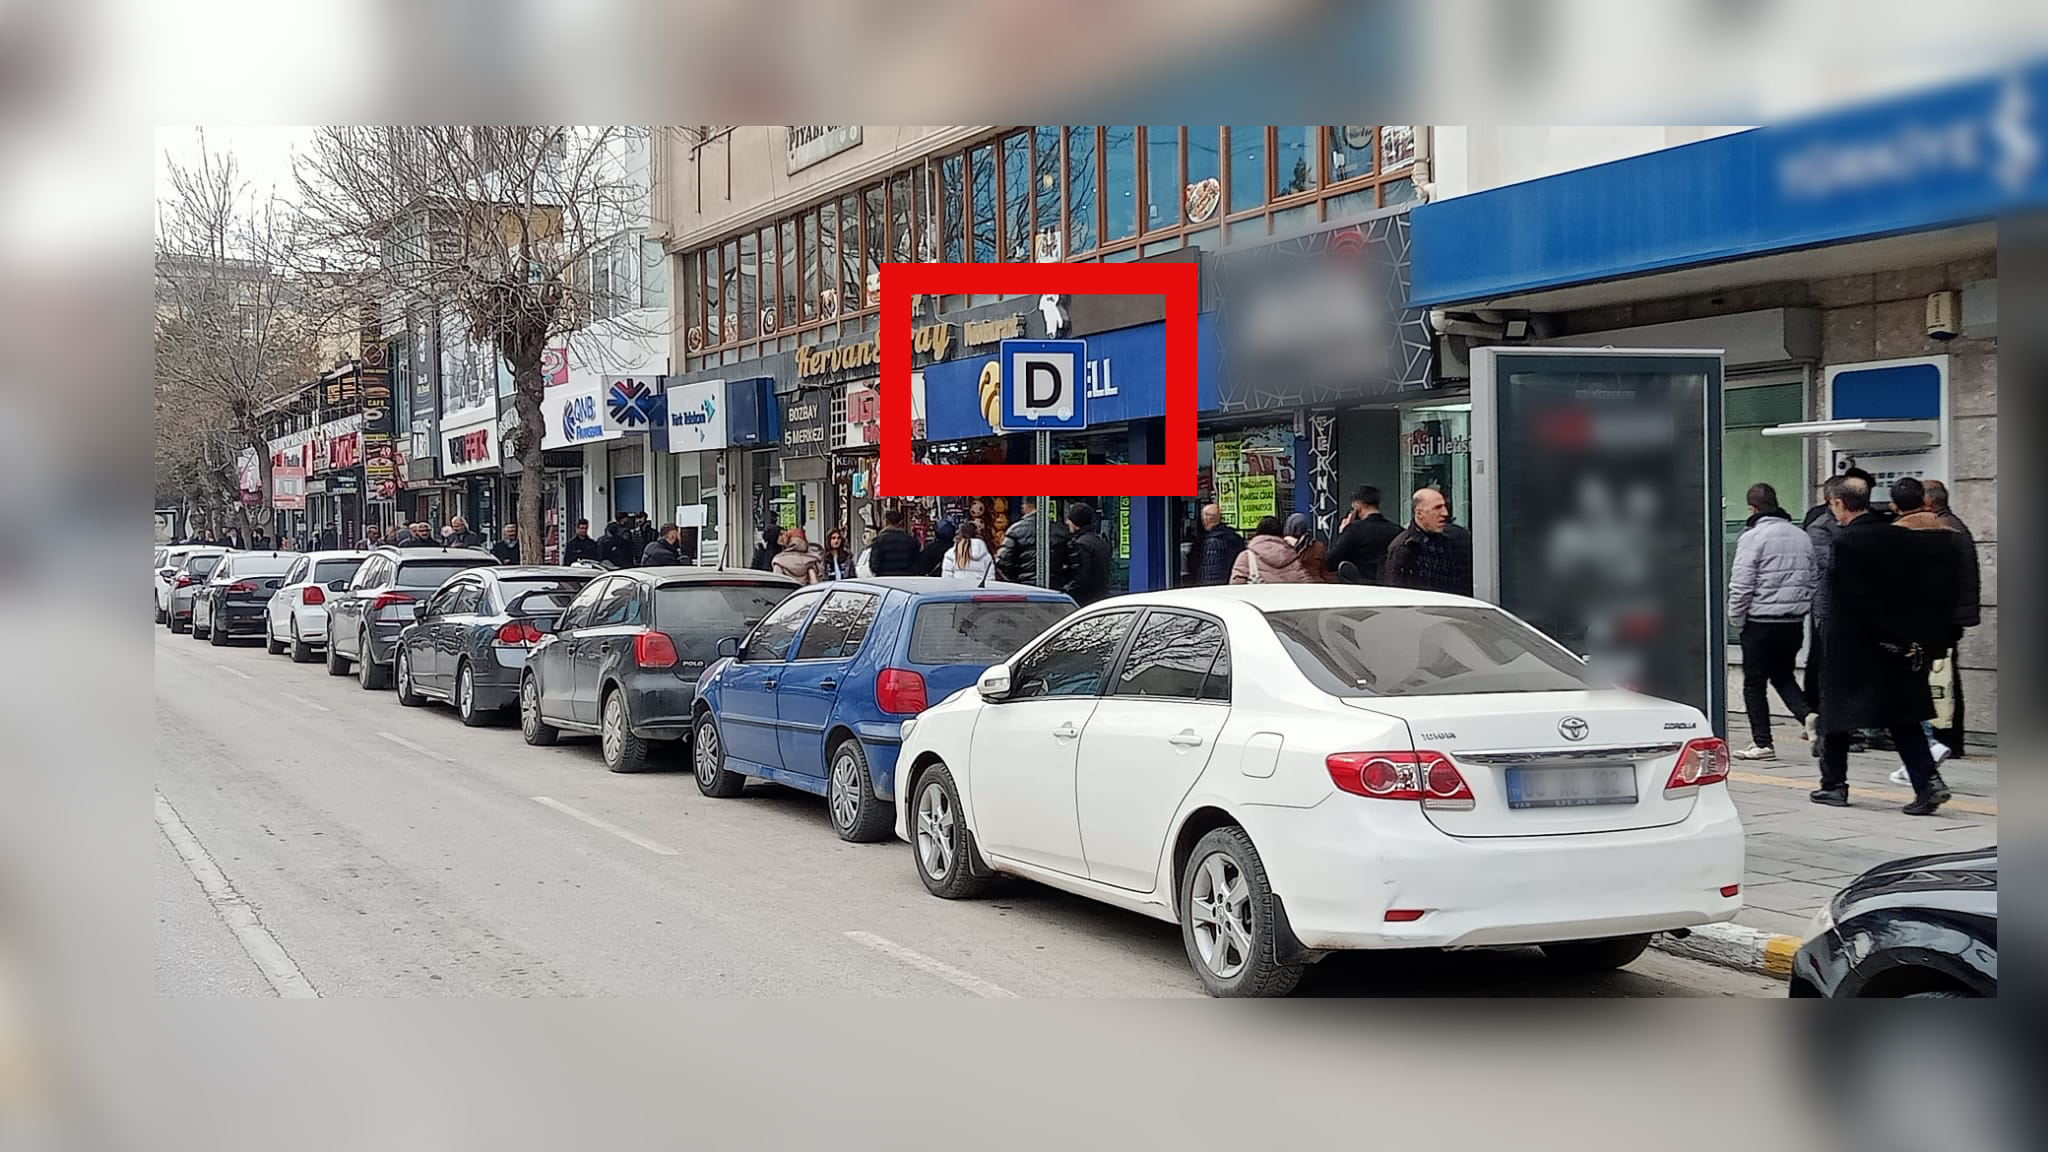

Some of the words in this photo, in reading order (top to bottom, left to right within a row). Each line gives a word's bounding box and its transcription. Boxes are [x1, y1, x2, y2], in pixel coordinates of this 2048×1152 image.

[1025, 361, 1062, 409] D
[574, 396, 595, 423] QNB
[788, 404, 818, 422] BOZBAY
[784, 428, 792, 448] İŞ
[792, 424, 824, 444] MERKEZİ
